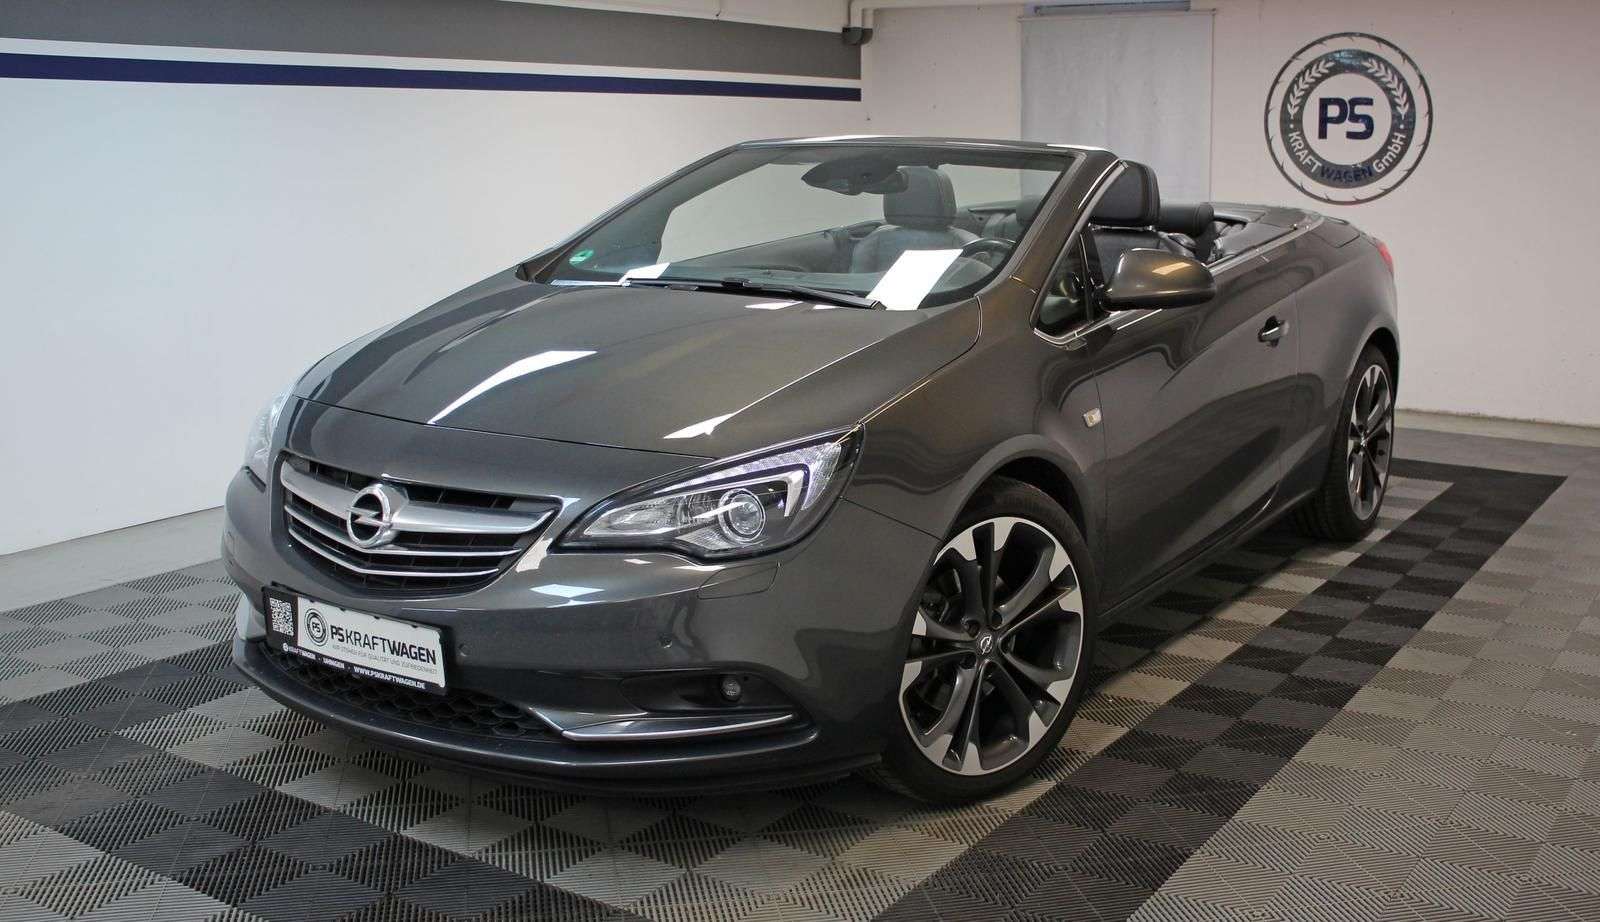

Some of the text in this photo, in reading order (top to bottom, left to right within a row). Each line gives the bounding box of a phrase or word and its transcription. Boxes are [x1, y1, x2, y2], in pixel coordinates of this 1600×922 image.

[1318, 96, 1374, 140] PS
[1372, 132, 1406, 172] GmbH
[353, 665, 426, 690] WWW.PSKRAFTWAGEN.DE
